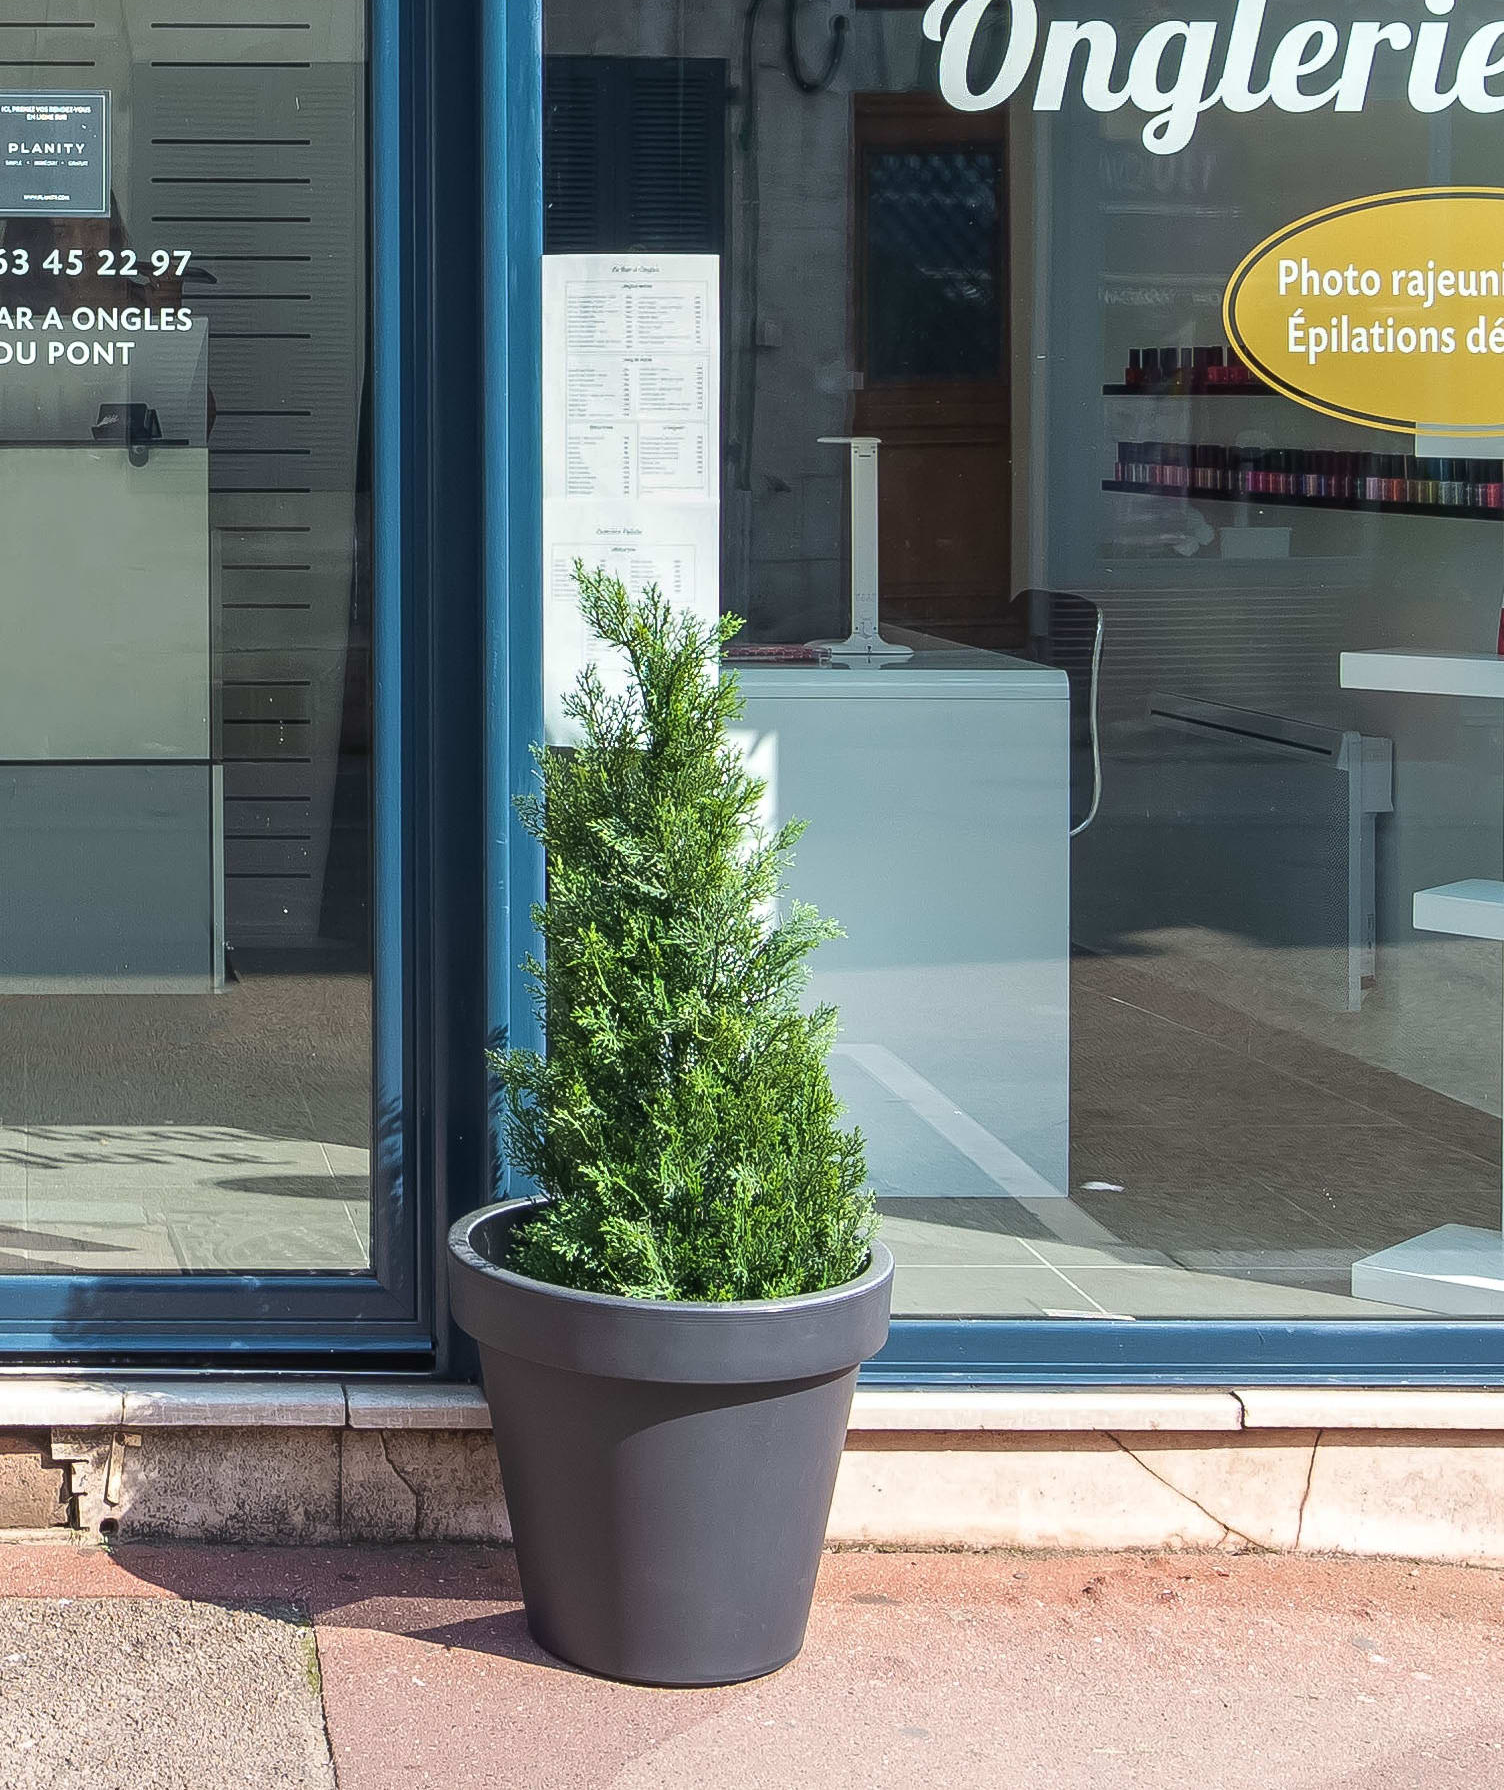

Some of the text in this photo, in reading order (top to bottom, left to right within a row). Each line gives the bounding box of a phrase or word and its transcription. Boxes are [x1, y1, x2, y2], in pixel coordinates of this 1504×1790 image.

[8, 142, 85, 154] PLANITY
[42, 248, 83, 276] 45
[97, 249, 138, 276] 22
[151, 249, 192, 277] 97
[1279, 258, 1381, 296] Photo
[41, 306, 64, 330] A
[71, 306, 192, 331] ONGLES
[1288, 308, 1456, 364] Épilations
[48, 341, 135, 365] PONT
